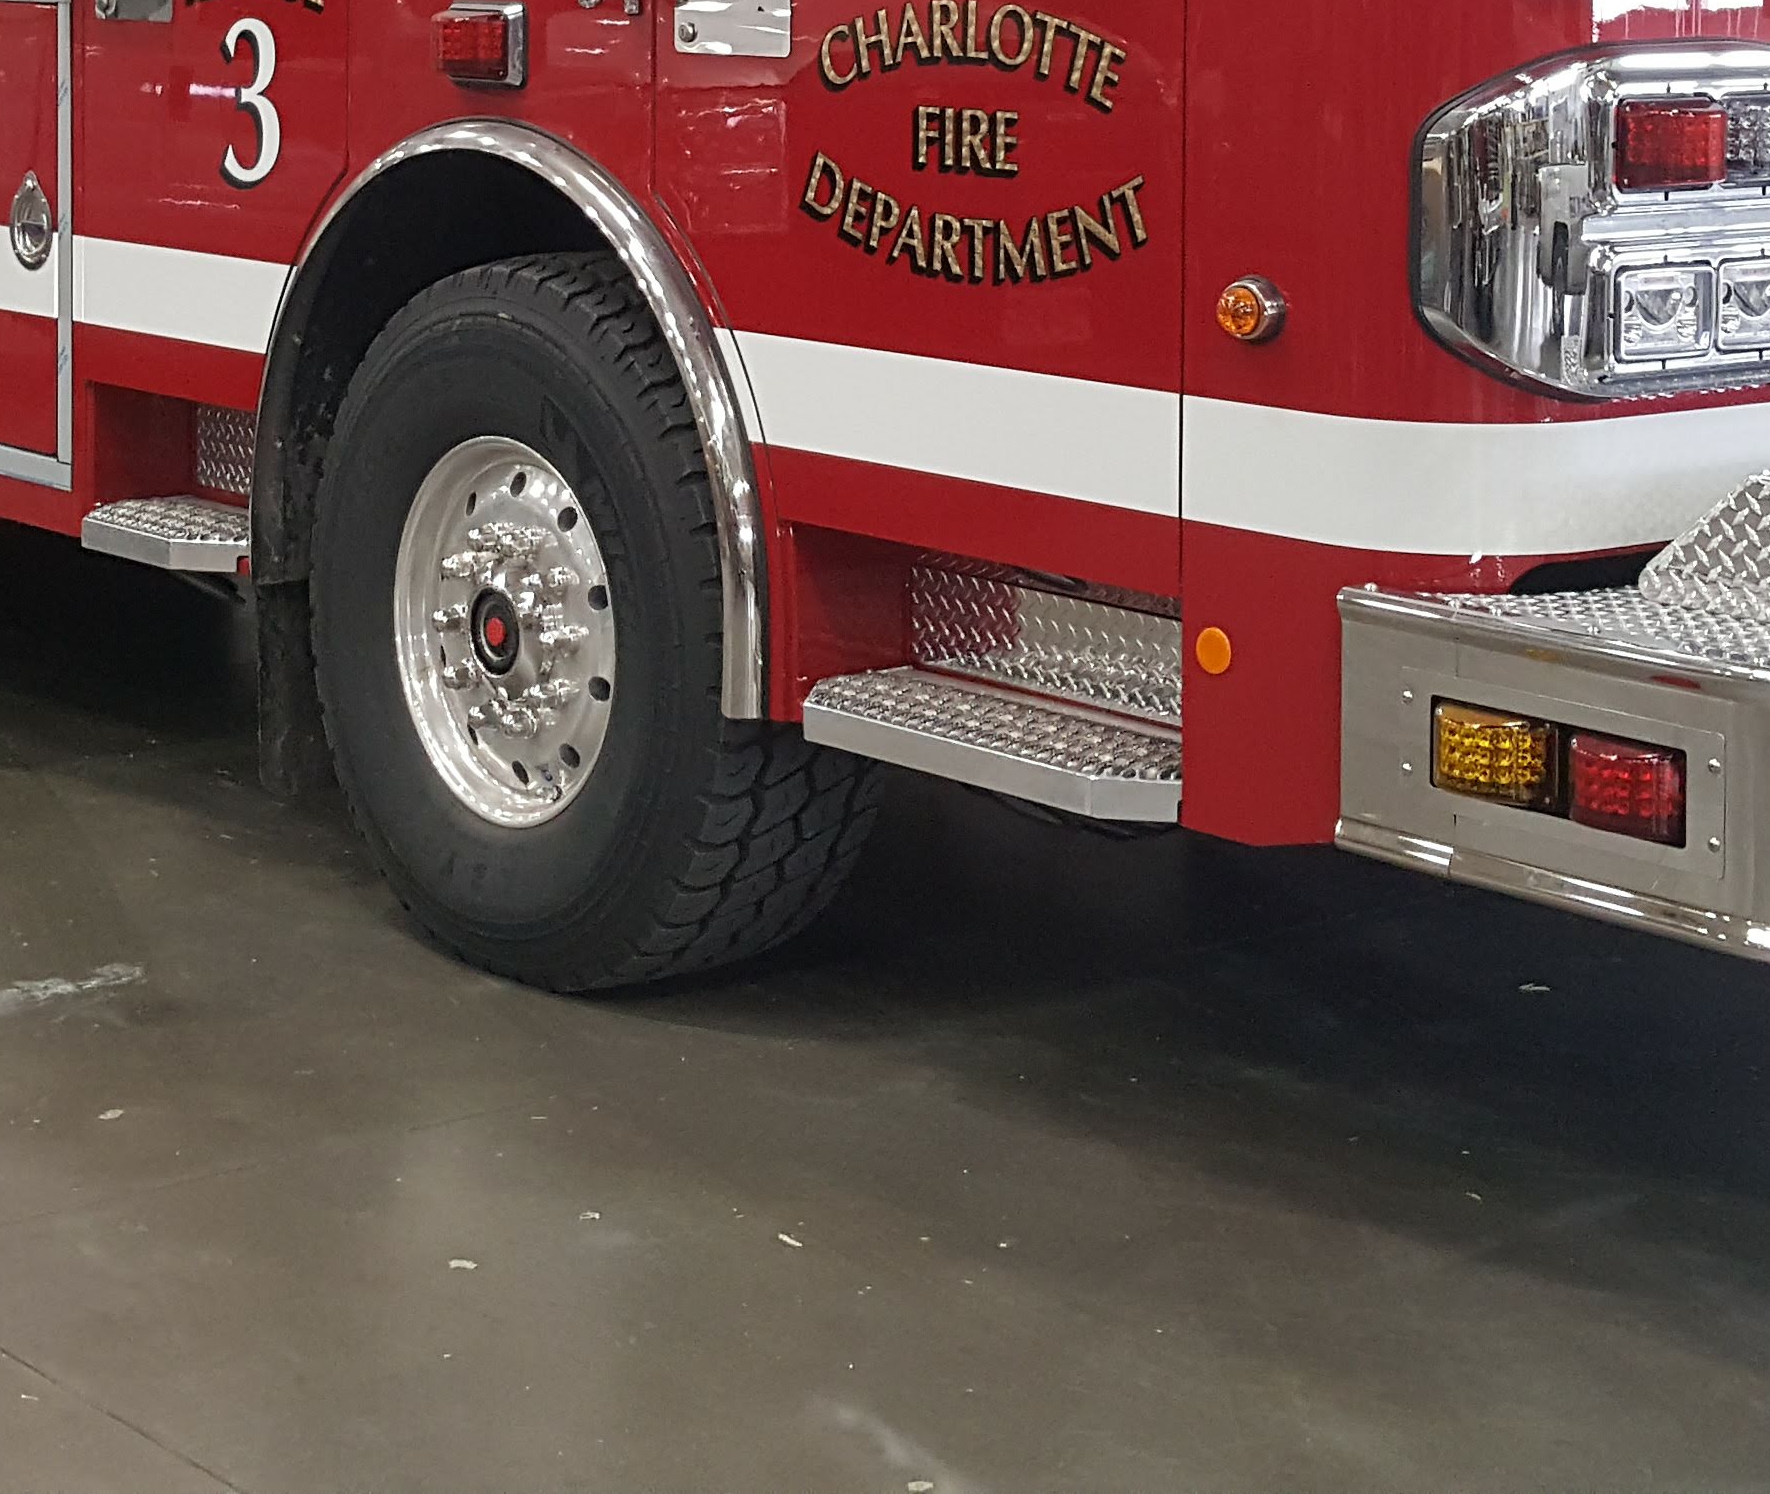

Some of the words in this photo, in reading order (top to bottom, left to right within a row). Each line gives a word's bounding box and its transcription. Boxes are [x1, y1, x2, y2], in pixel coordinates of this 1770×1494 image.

[219, 17, 281, 190] 3
[818, 0, 1126, 113] CHARLOTTE
[913, 106, 1019, 177] FIRE
[800, 151, 1149, 286] DEPARTMENT
